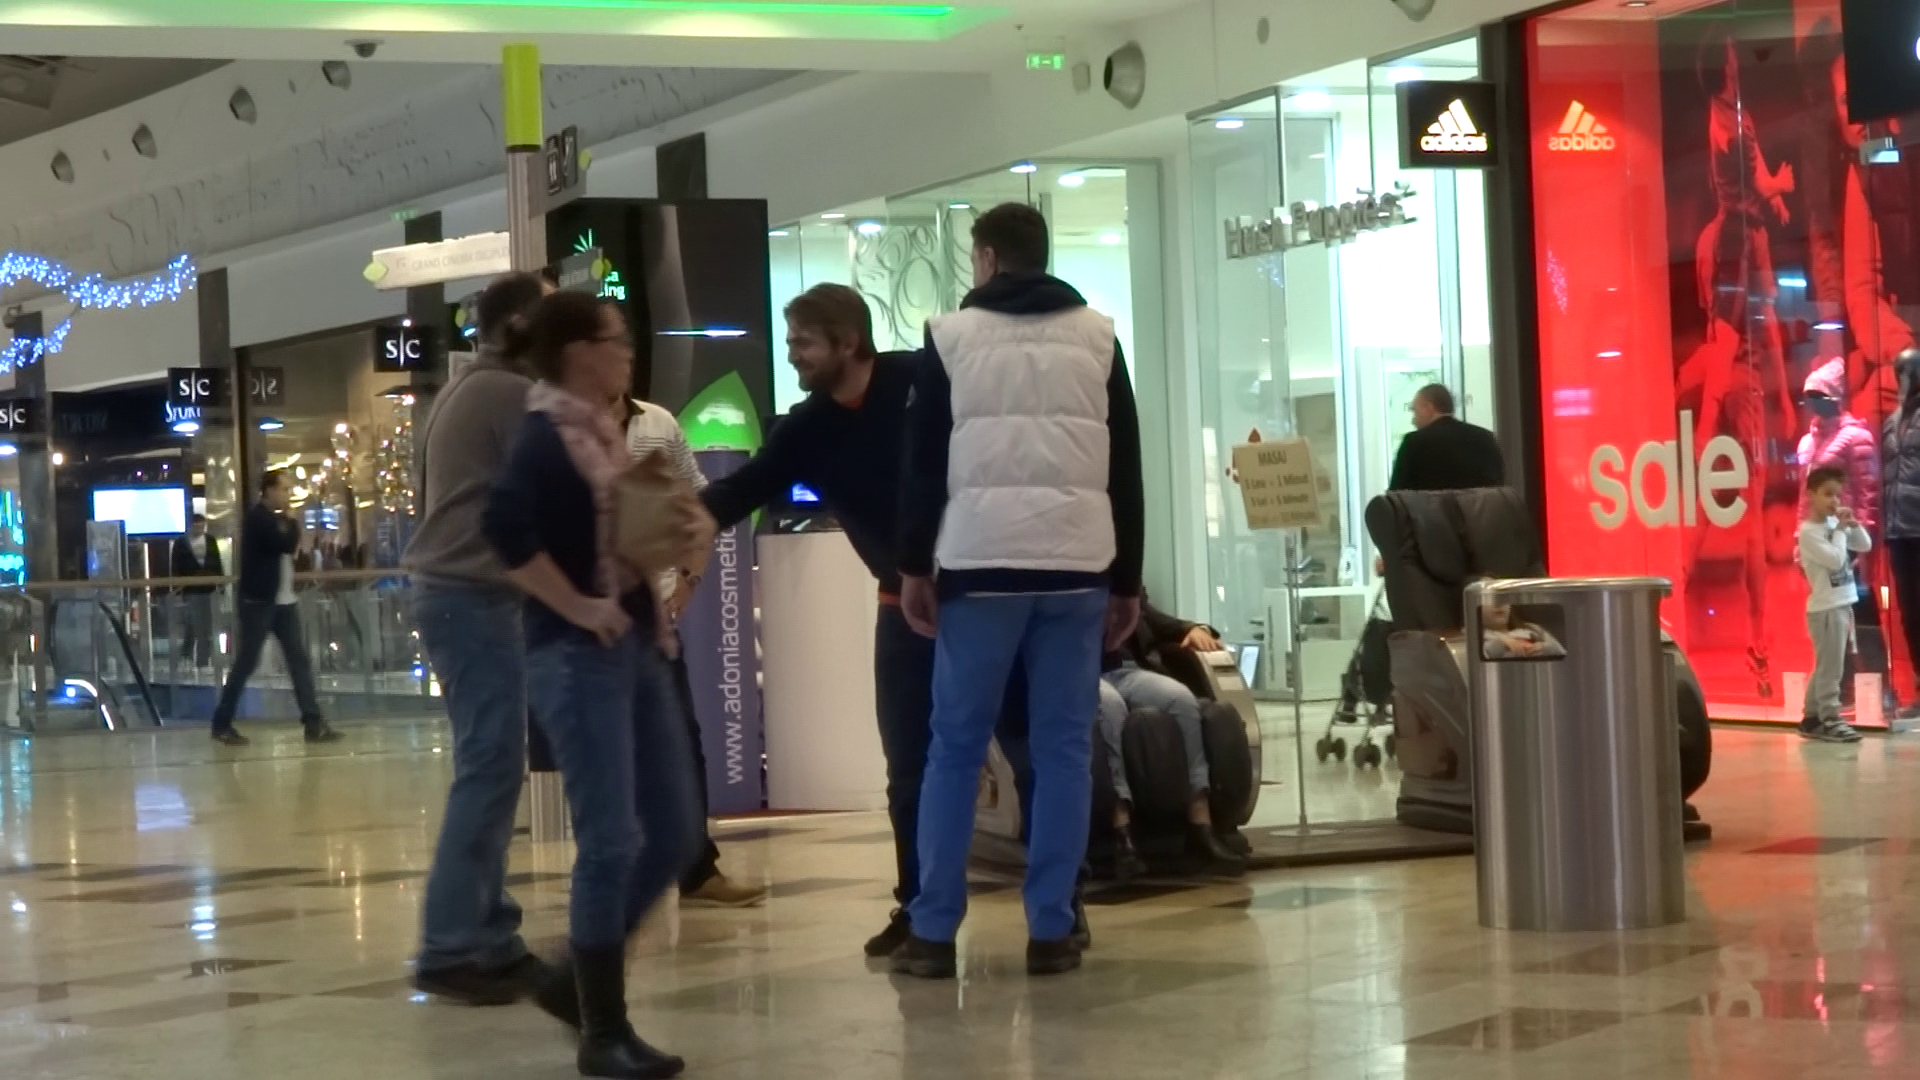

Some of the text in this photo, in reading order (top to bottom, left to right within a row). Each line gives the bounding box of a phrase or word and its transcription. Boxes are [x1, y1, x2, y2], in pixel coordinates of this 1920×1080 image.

[1420, 135, 1489, 152] adidas
[1589, 409, 1749, 530] sale
[715, 525, 744, 785] www.adoniacosmetic
